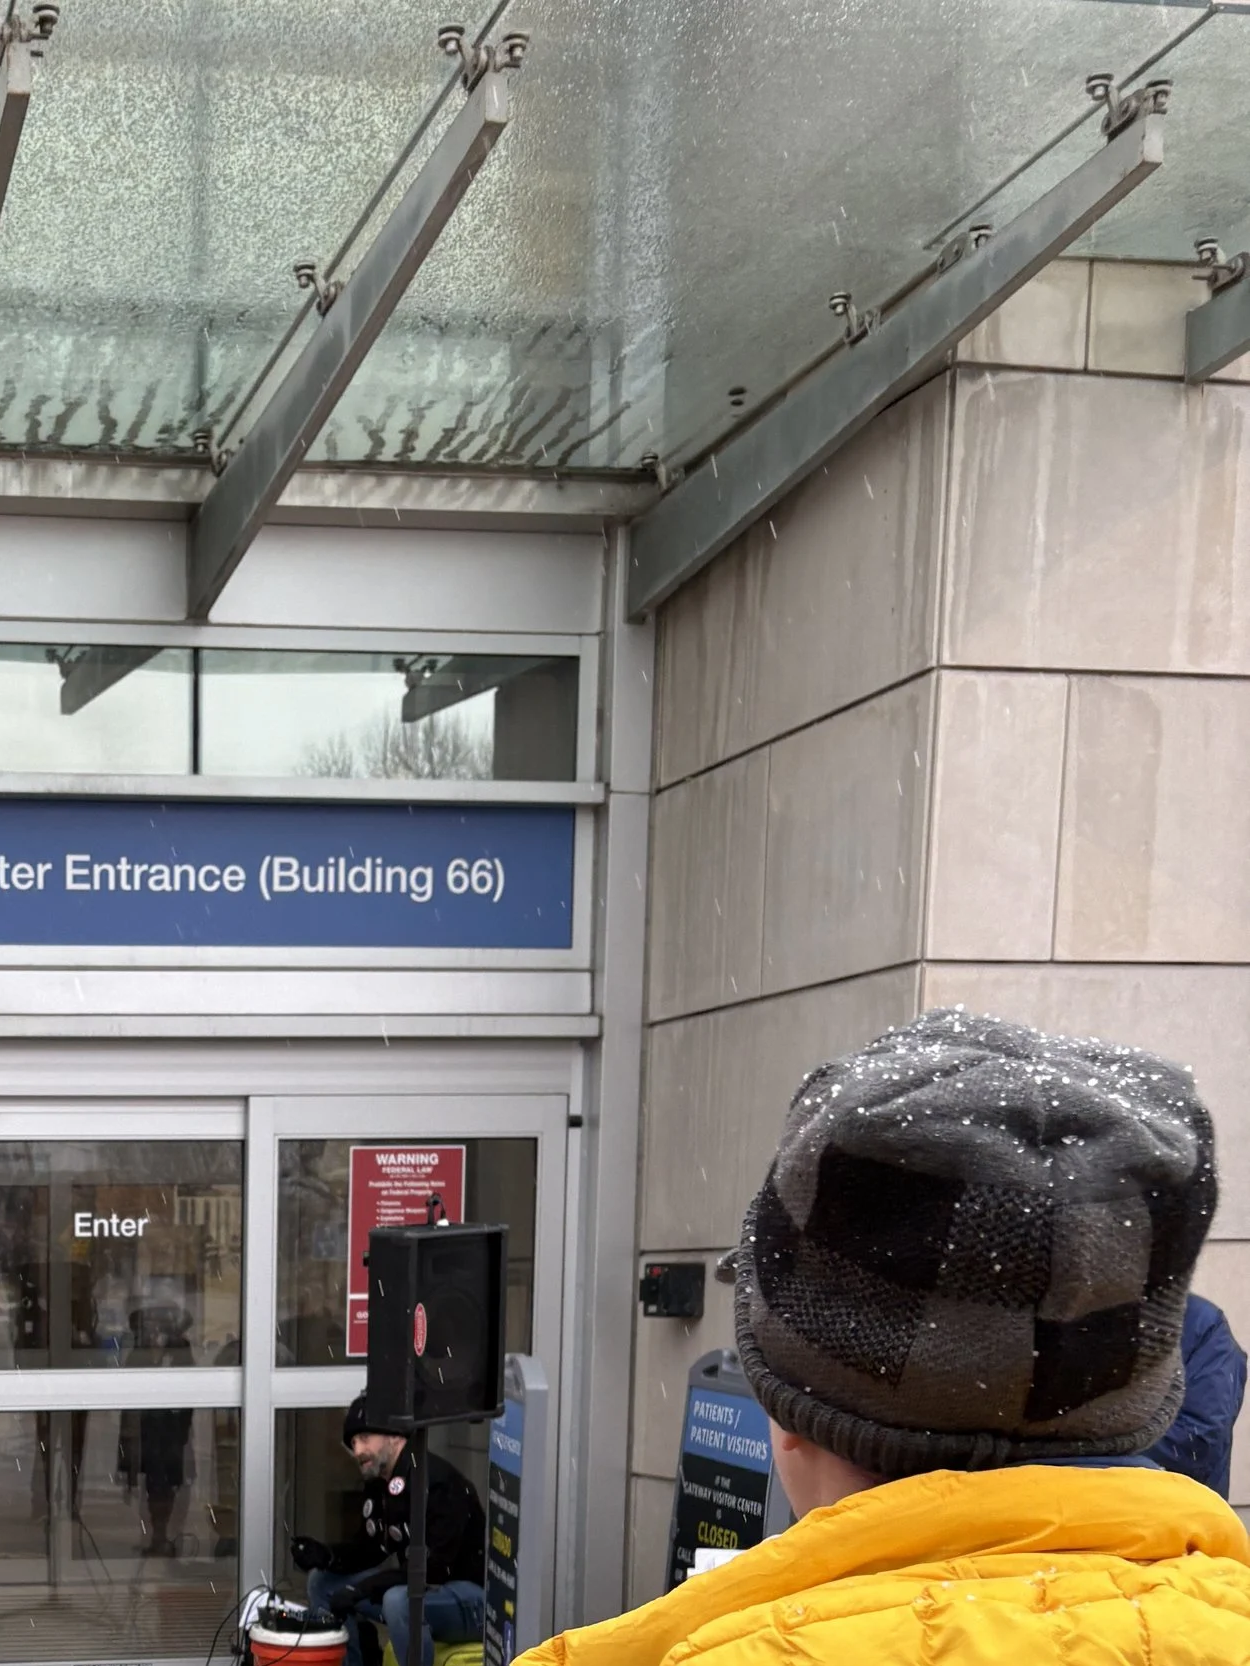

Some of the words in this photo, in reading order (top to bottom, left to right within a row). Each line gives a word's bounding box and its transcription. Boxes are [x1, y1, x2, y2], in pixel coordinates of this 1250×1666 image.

[64, 854, 246, 892] Entrance
[259, 856, 434, 902] (Building
[446, 857, 506, 902] 66)
[375, 1152, 439, 1166] WARNING
[381, 1166, 415, 1174] FEDERAL
[416, 1166, 434, 1174] LAW
[74, 1212, 149, 1238] Enter
[693, 1400, 734, 1425] PATIENTS
[734, 1409, 741, 1430] /
[690, 1426, 726, 1449] PATIENT
[713, 1489, 737, 1509] VISITOR
[737, 1497, 763, 1517] CENTER
[698, 1521, 739, 1549] CLOSED
